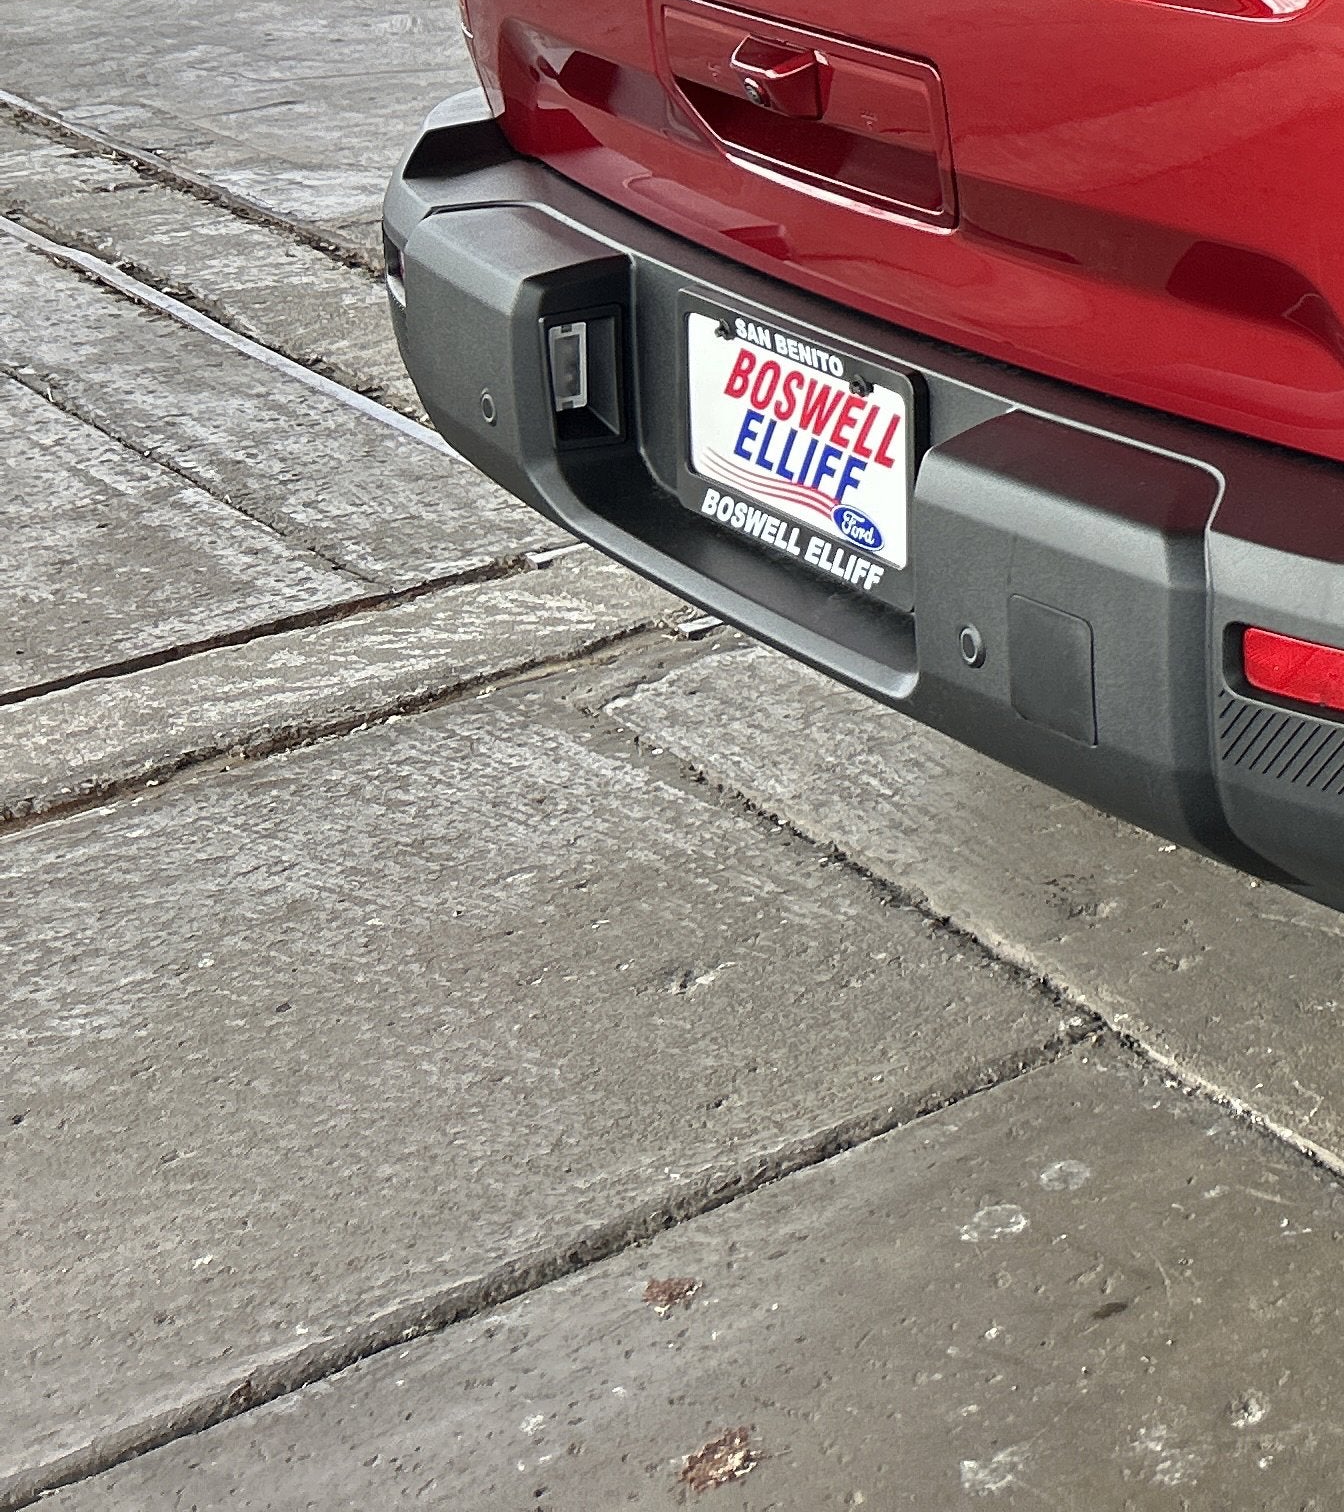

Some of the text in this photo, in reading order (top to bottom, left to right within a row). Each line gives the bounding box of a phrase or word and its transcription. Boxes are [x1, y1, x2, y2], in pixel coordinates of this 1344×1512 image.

[734, 318, 844, 377] SAN BENITO
[724, 348, 902, 468] BOSWELL
[733, 408, 868, 505] ELLIFF
[701, 488, 884, 590] BOSWELL ELLIFF
[841, 510, 875, 546] Ford
